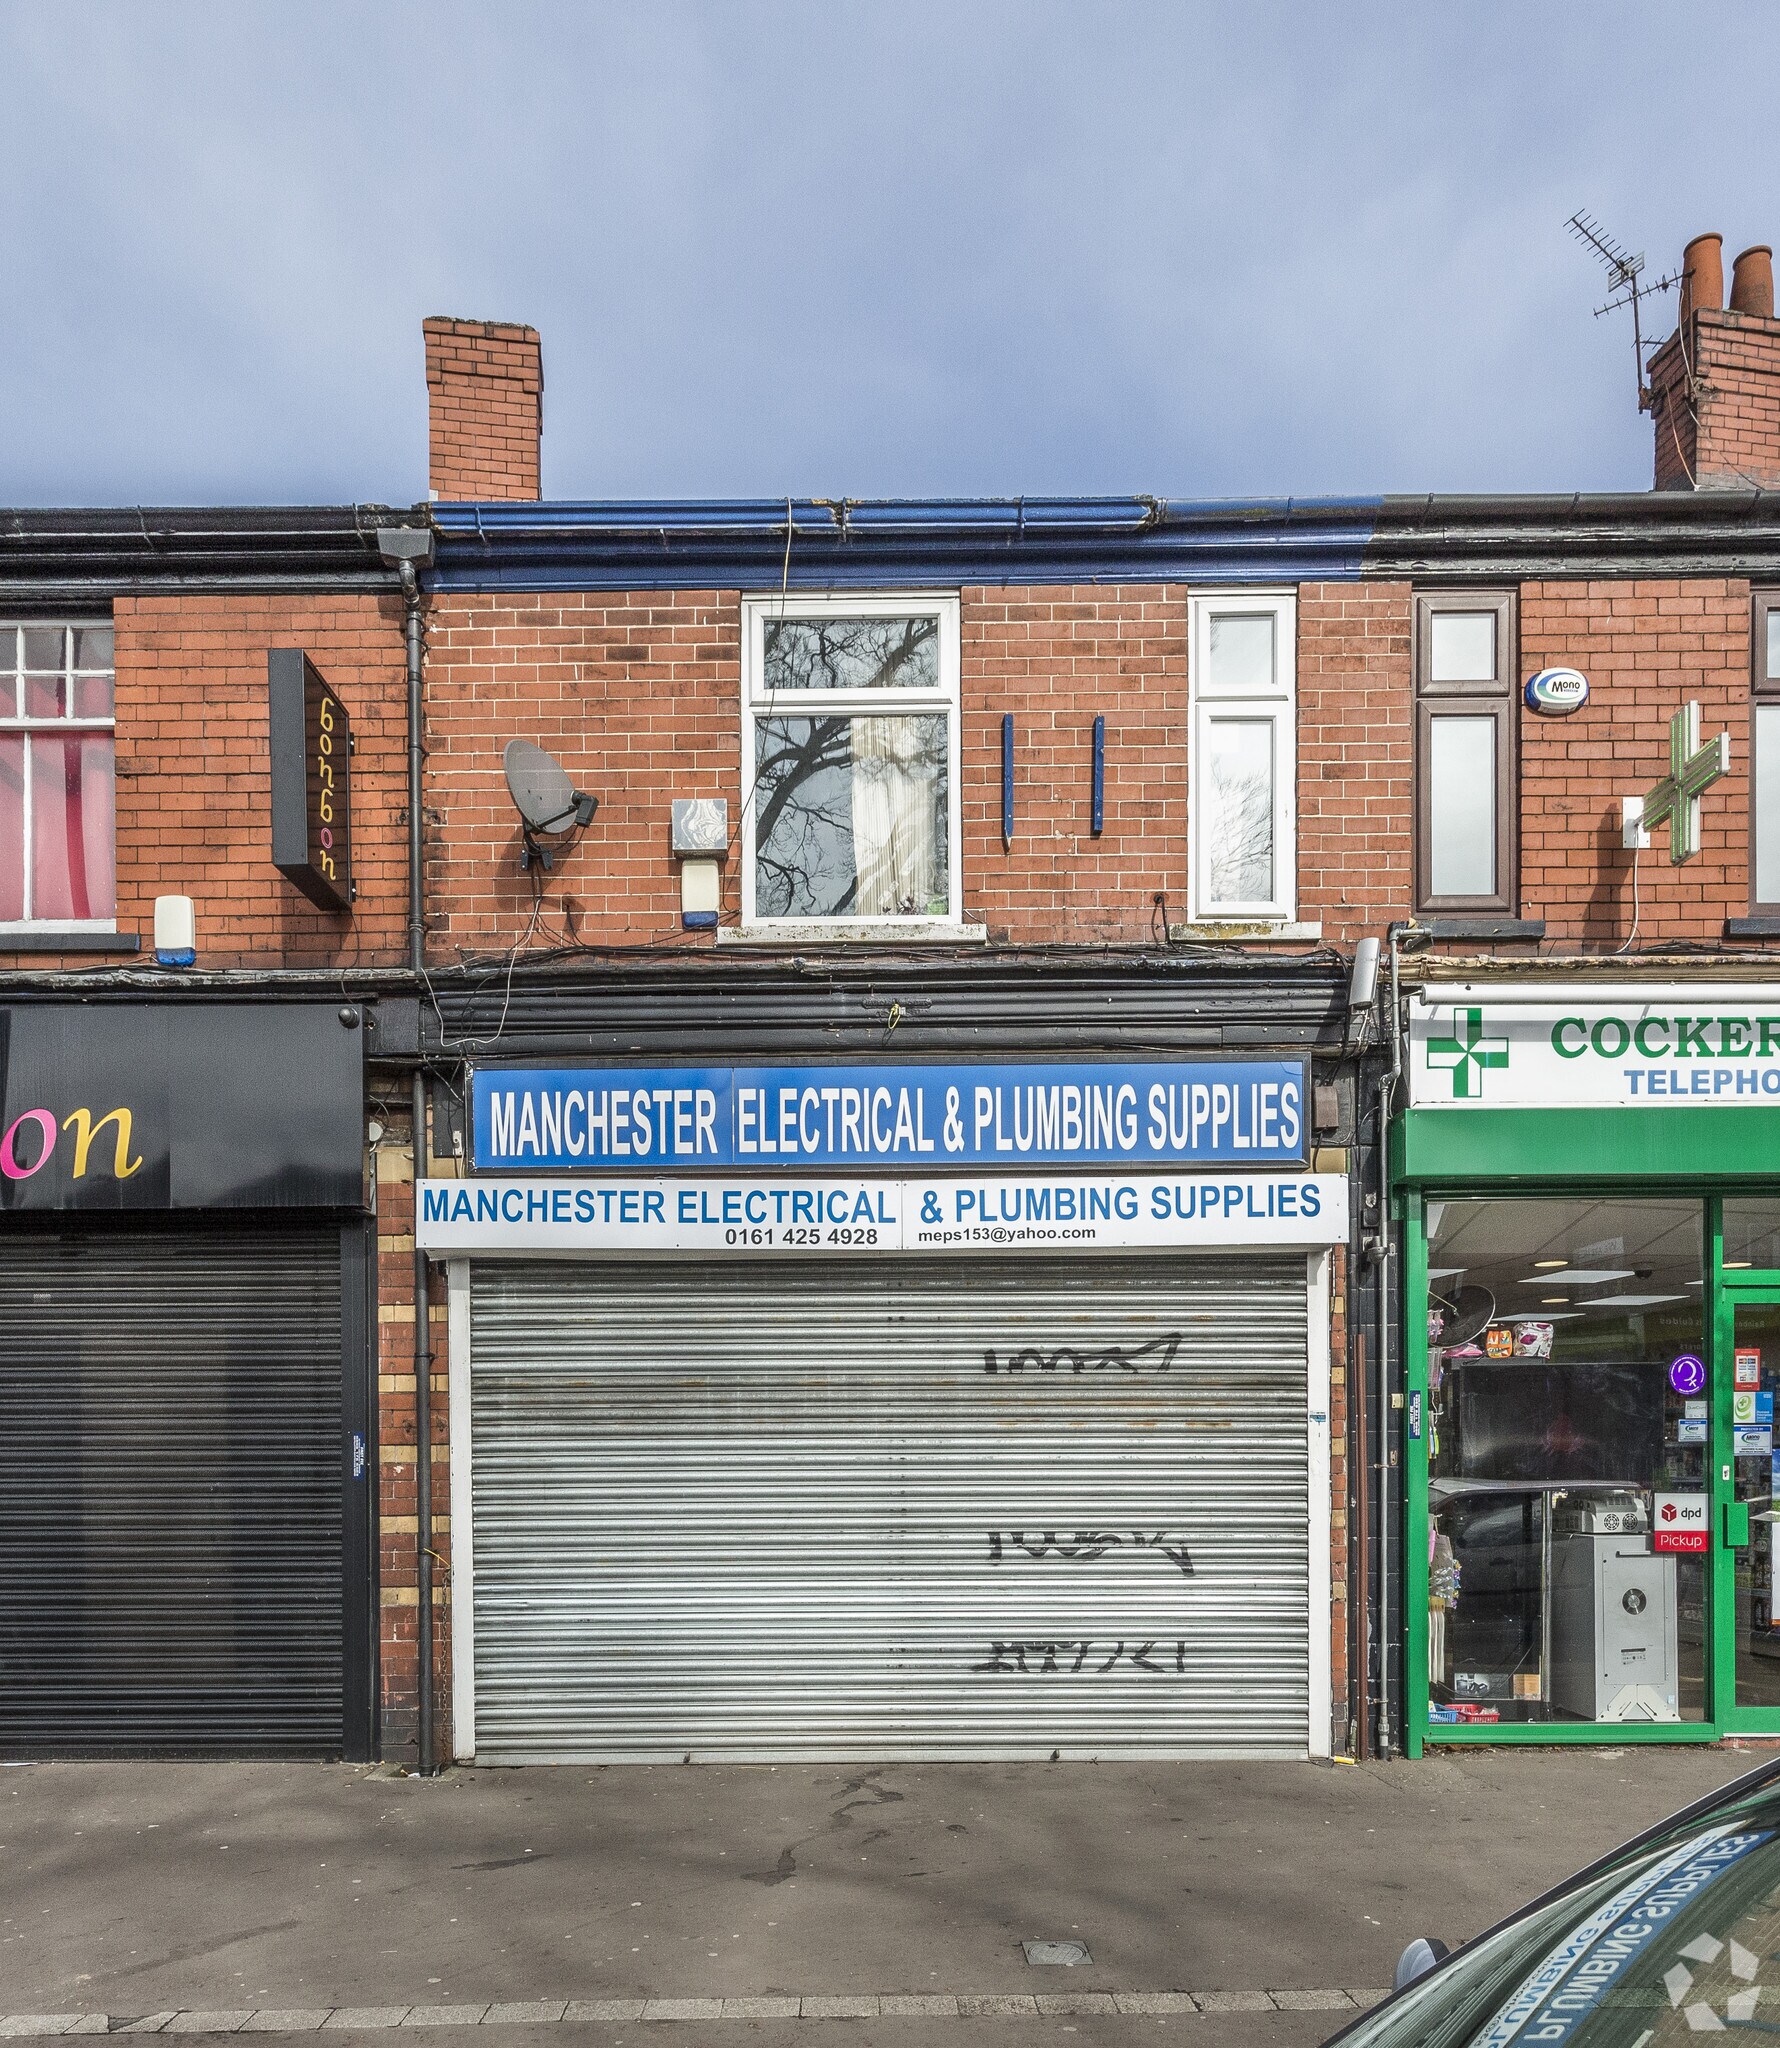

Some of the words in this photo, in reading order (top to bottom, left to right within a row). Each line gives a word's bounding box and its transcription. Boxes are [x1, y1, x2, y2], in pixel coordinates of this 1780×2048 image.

[1551, 681, 1580, 692] Mono
[1624, 1069, 1780, 1094] TELEPHO
[491, 1089, 718, 1156] MANCHESTER
[738, 1086, 934, 1154] ELECTRICAL
[943, 1086, 965, 1152] &
[974, 1083, 1138, 1152] PLUMBING
[1147, 1081, 1300, 1150] SUPPLIES
[0, 1107, 143, 1180] on
[424, 1189, 666, 1223] MANCHESTER
[677, 1189, 896, 1224] ELECTRICAL
[920, 1190, 943, 1224] &
[956, 1186, 1138, 1222] PLUMBING
[1150, 1184, 1321, 1220] SUPPLIES
[725, 1228, 774, 1245] 0161
[782, 1228, 821, 1245] 425
[827, 1228, 878, 1245] 4928
[918, 1226, 1096, 1243] meps153@yahoo.com
[1681, 1507, 1701, 1520] dpd
[1660, 1534, 1702, 1548] Pickup
